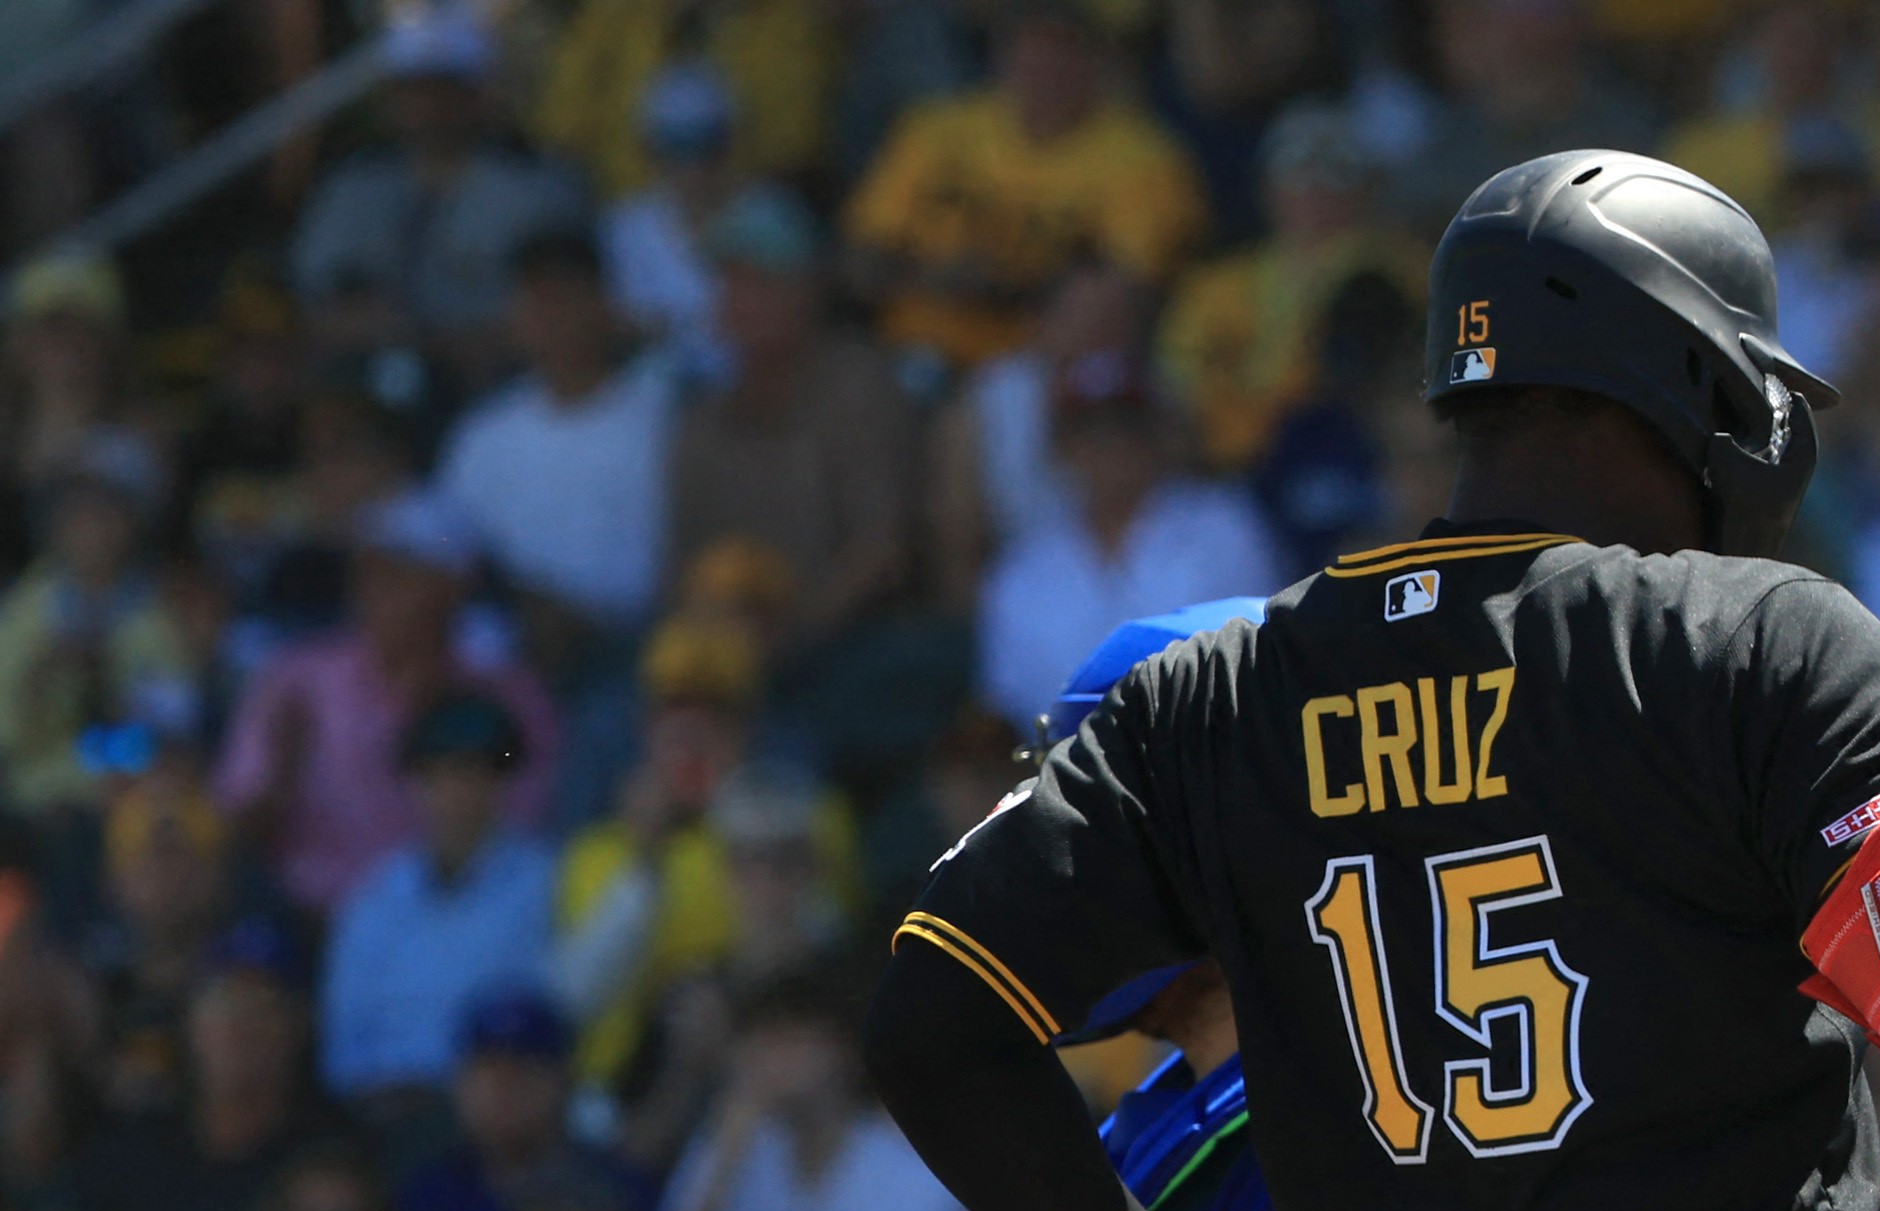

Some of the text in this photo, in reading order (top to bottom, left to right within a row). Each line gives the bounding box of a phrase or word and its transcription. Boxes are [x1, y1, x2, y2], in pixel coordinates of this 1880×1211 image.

[1457, 300, 1490, 346] 15
[1301, 666, 1516, 818] CRUZ
[1304, 834, 1595, 1165] 15
